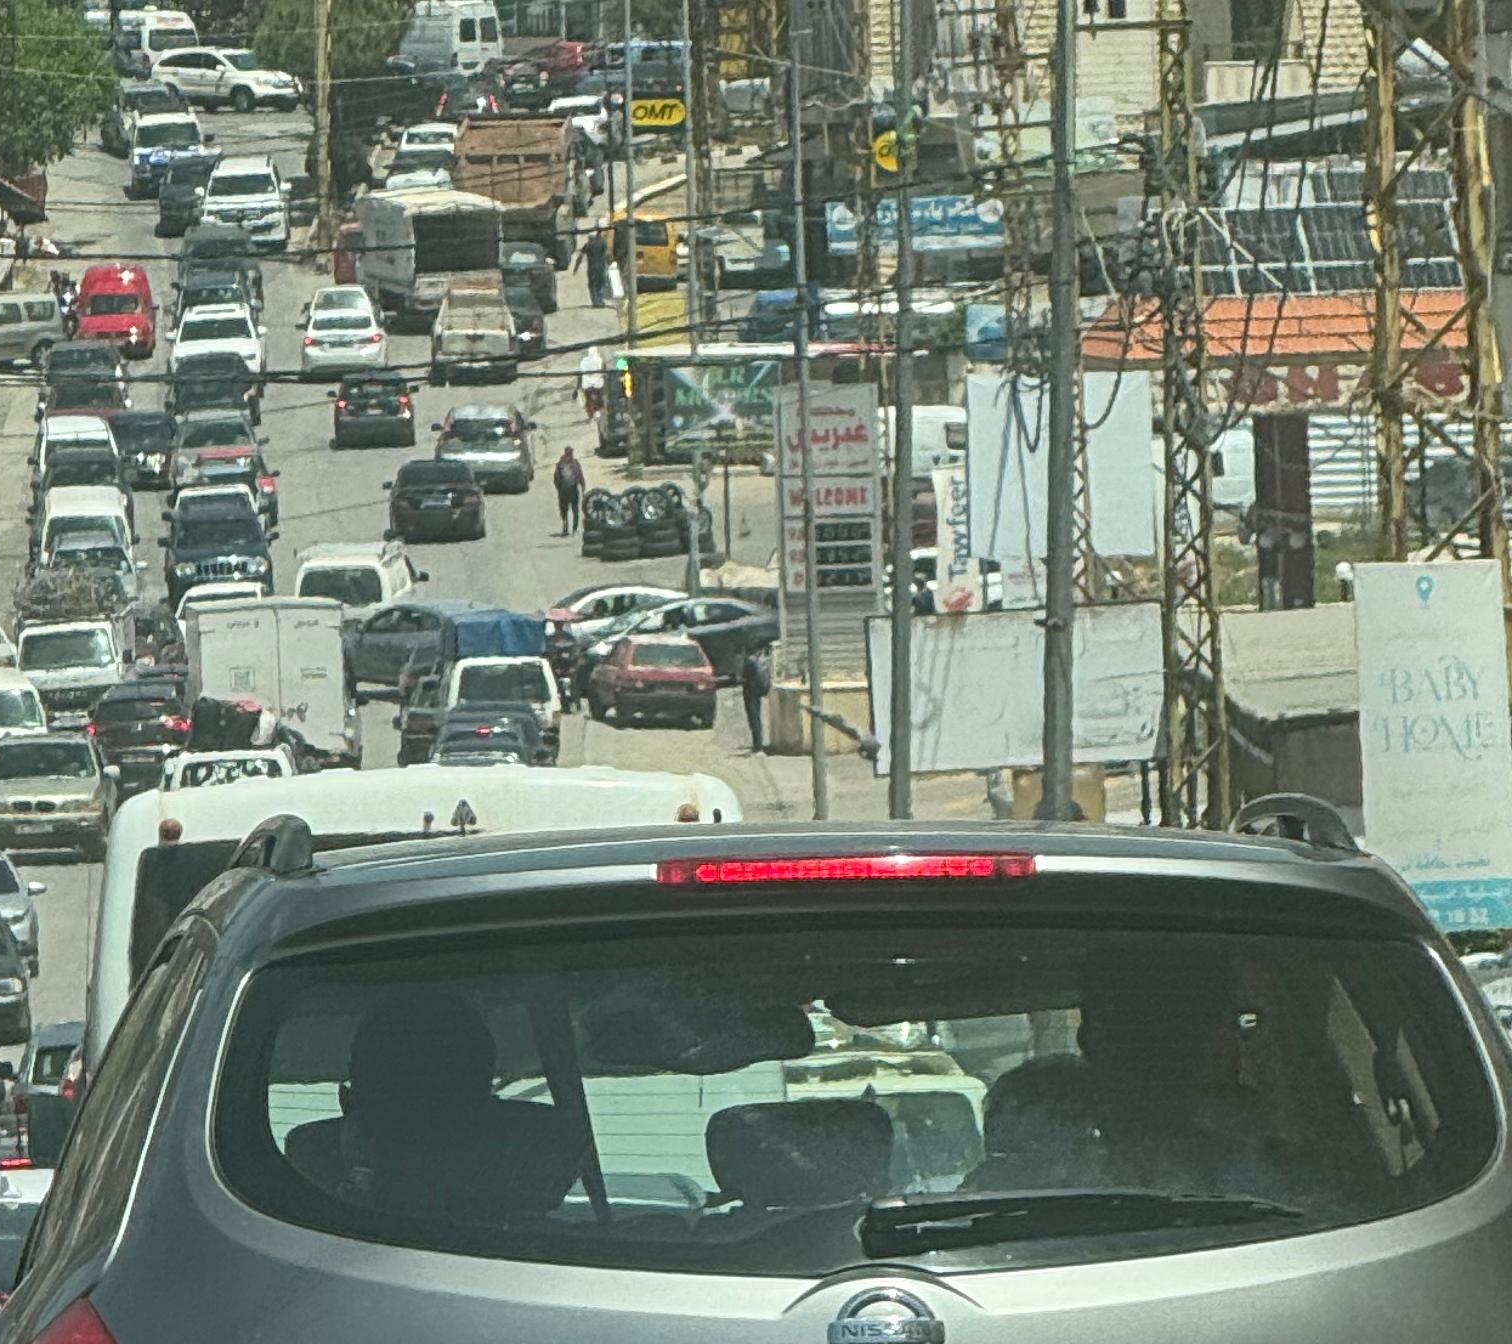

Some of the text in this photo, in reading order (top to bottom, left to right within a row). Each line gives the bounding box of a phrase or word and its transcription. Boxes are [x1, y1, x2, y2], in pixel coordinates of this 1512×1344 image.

[633, 104, 678, 121] OMT
[1381, 655, 1483, 704] BABY
[1372, 711, 1494, 761] HOME
